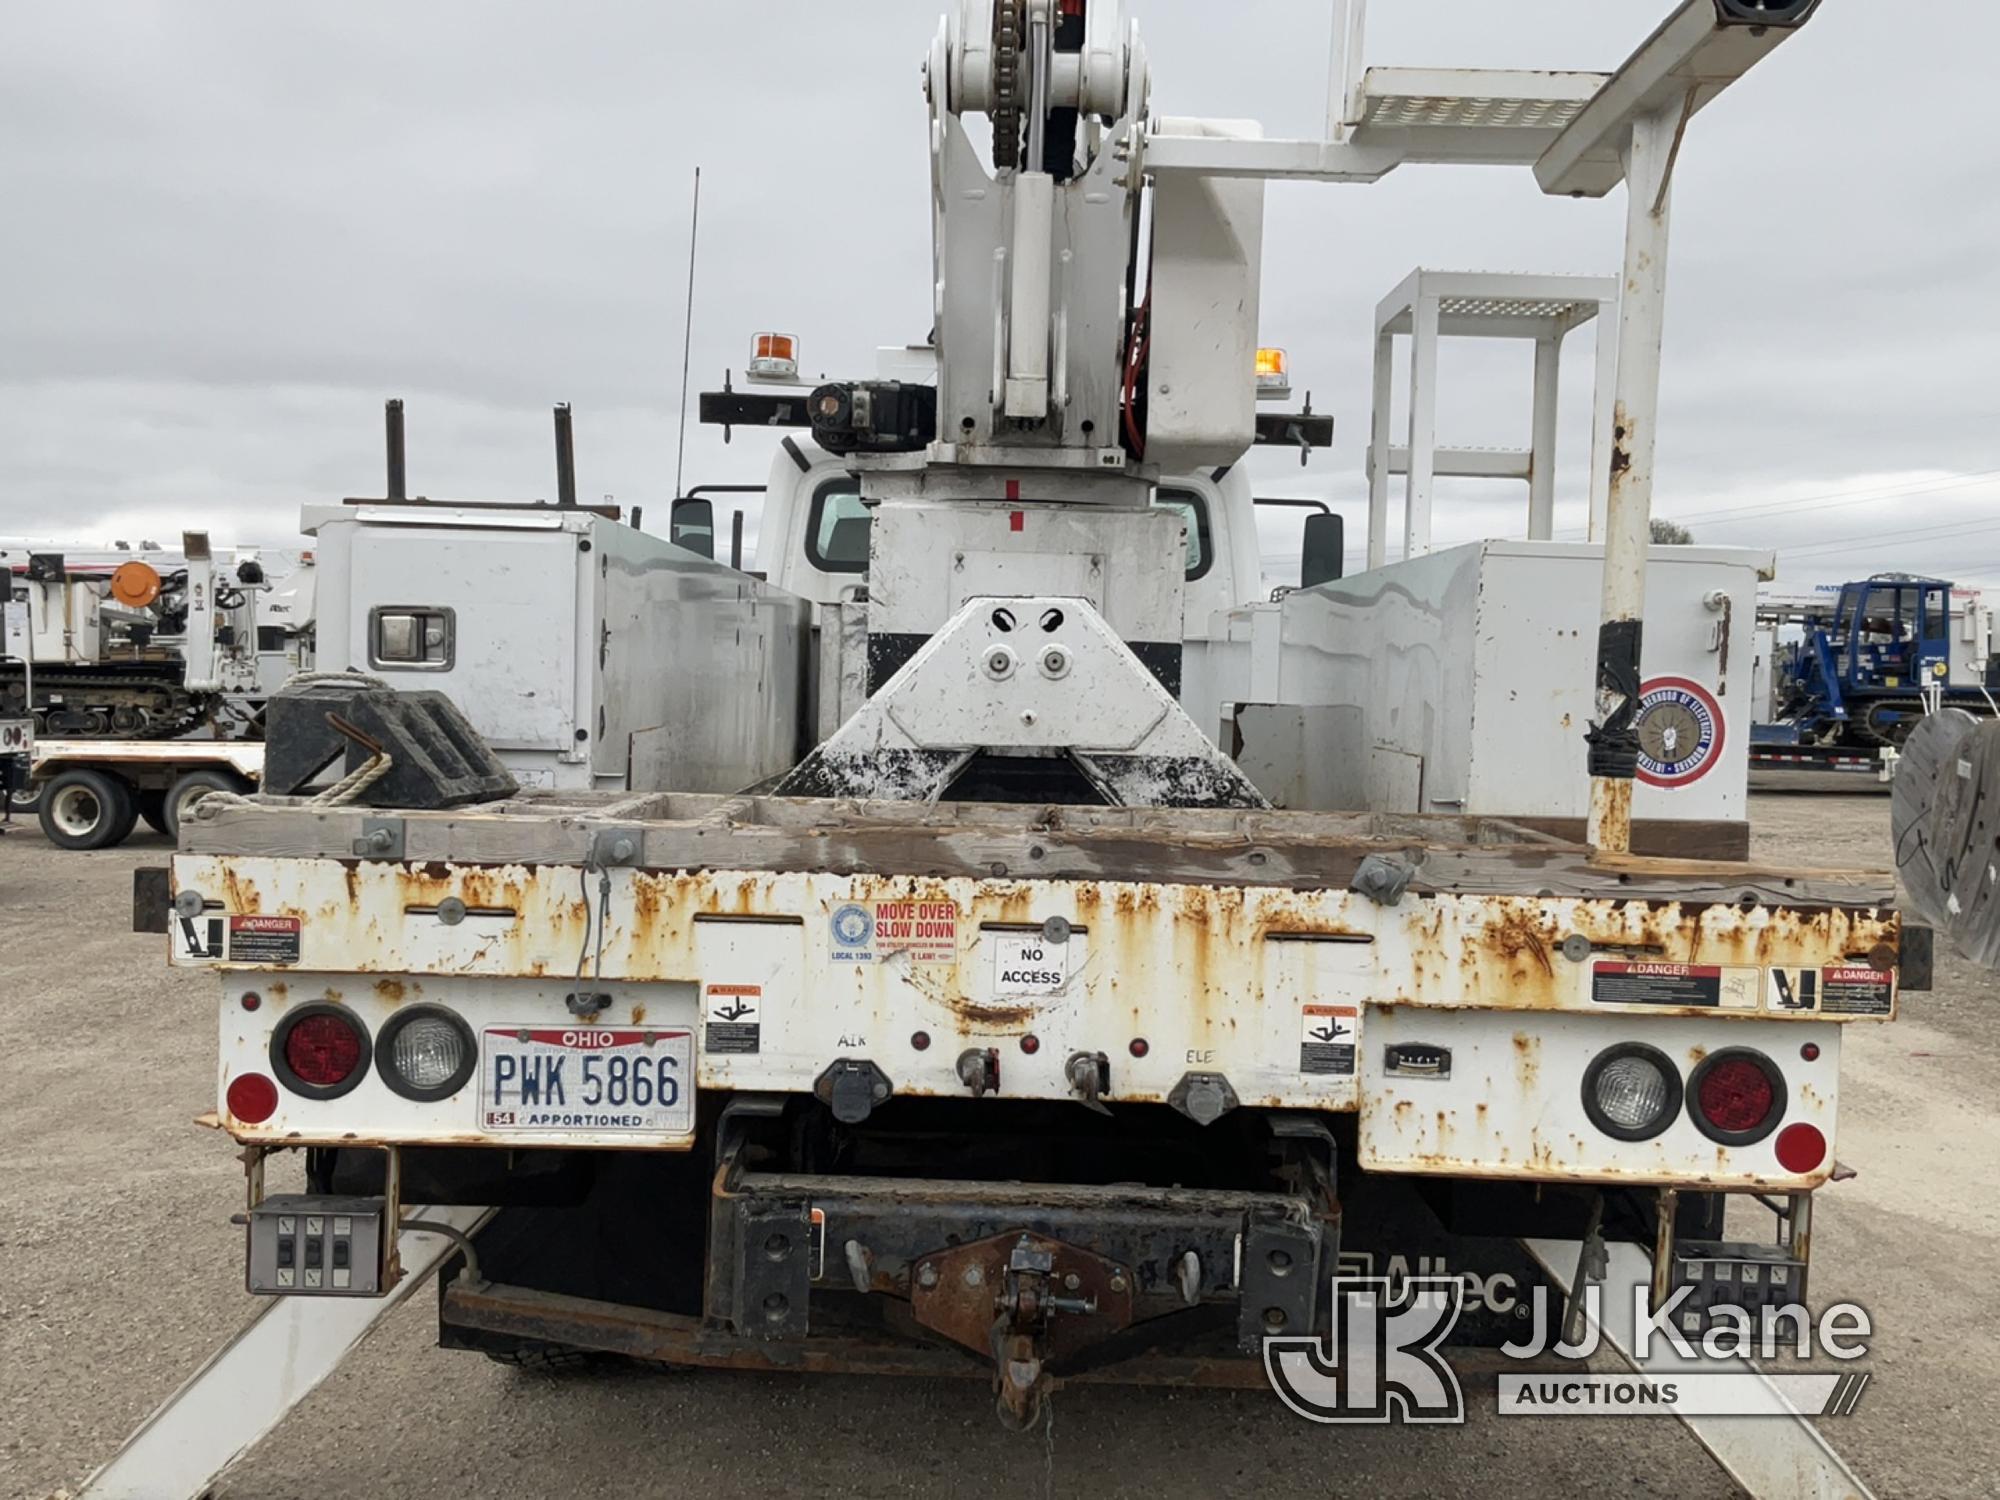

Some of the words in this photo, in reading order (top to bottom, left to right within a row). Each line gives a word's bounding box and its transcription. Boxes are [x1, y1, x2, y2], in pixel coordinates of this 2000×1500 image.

[876, 903, 915, 920] MOVE
[920, 904, 954, 920] OVER
[252, 919, 292, 929] DANGER
[876, 922, 912, 938] SLOW
[916, 922, 954, 938] DOWN
[832, 952, 853, 960] LOCAL
[855, 952, 872, 960] 1393
[1021, 949, 1043, 961] NO
[1637, 964, 1690, 976] DANGER
[1843, 970, 1884, 980] DANGER
[1001, 970, 1061, 984] ACCESS
[562, 1032, 614, 1047] OHIO
[494, 1055, 566, 1106] PWK
[582, 1055, 679, 1107] 5866
[528, 1114, 643, 1127] APPORTIONED
[1377, 1255, 1516, 1313] Altec
